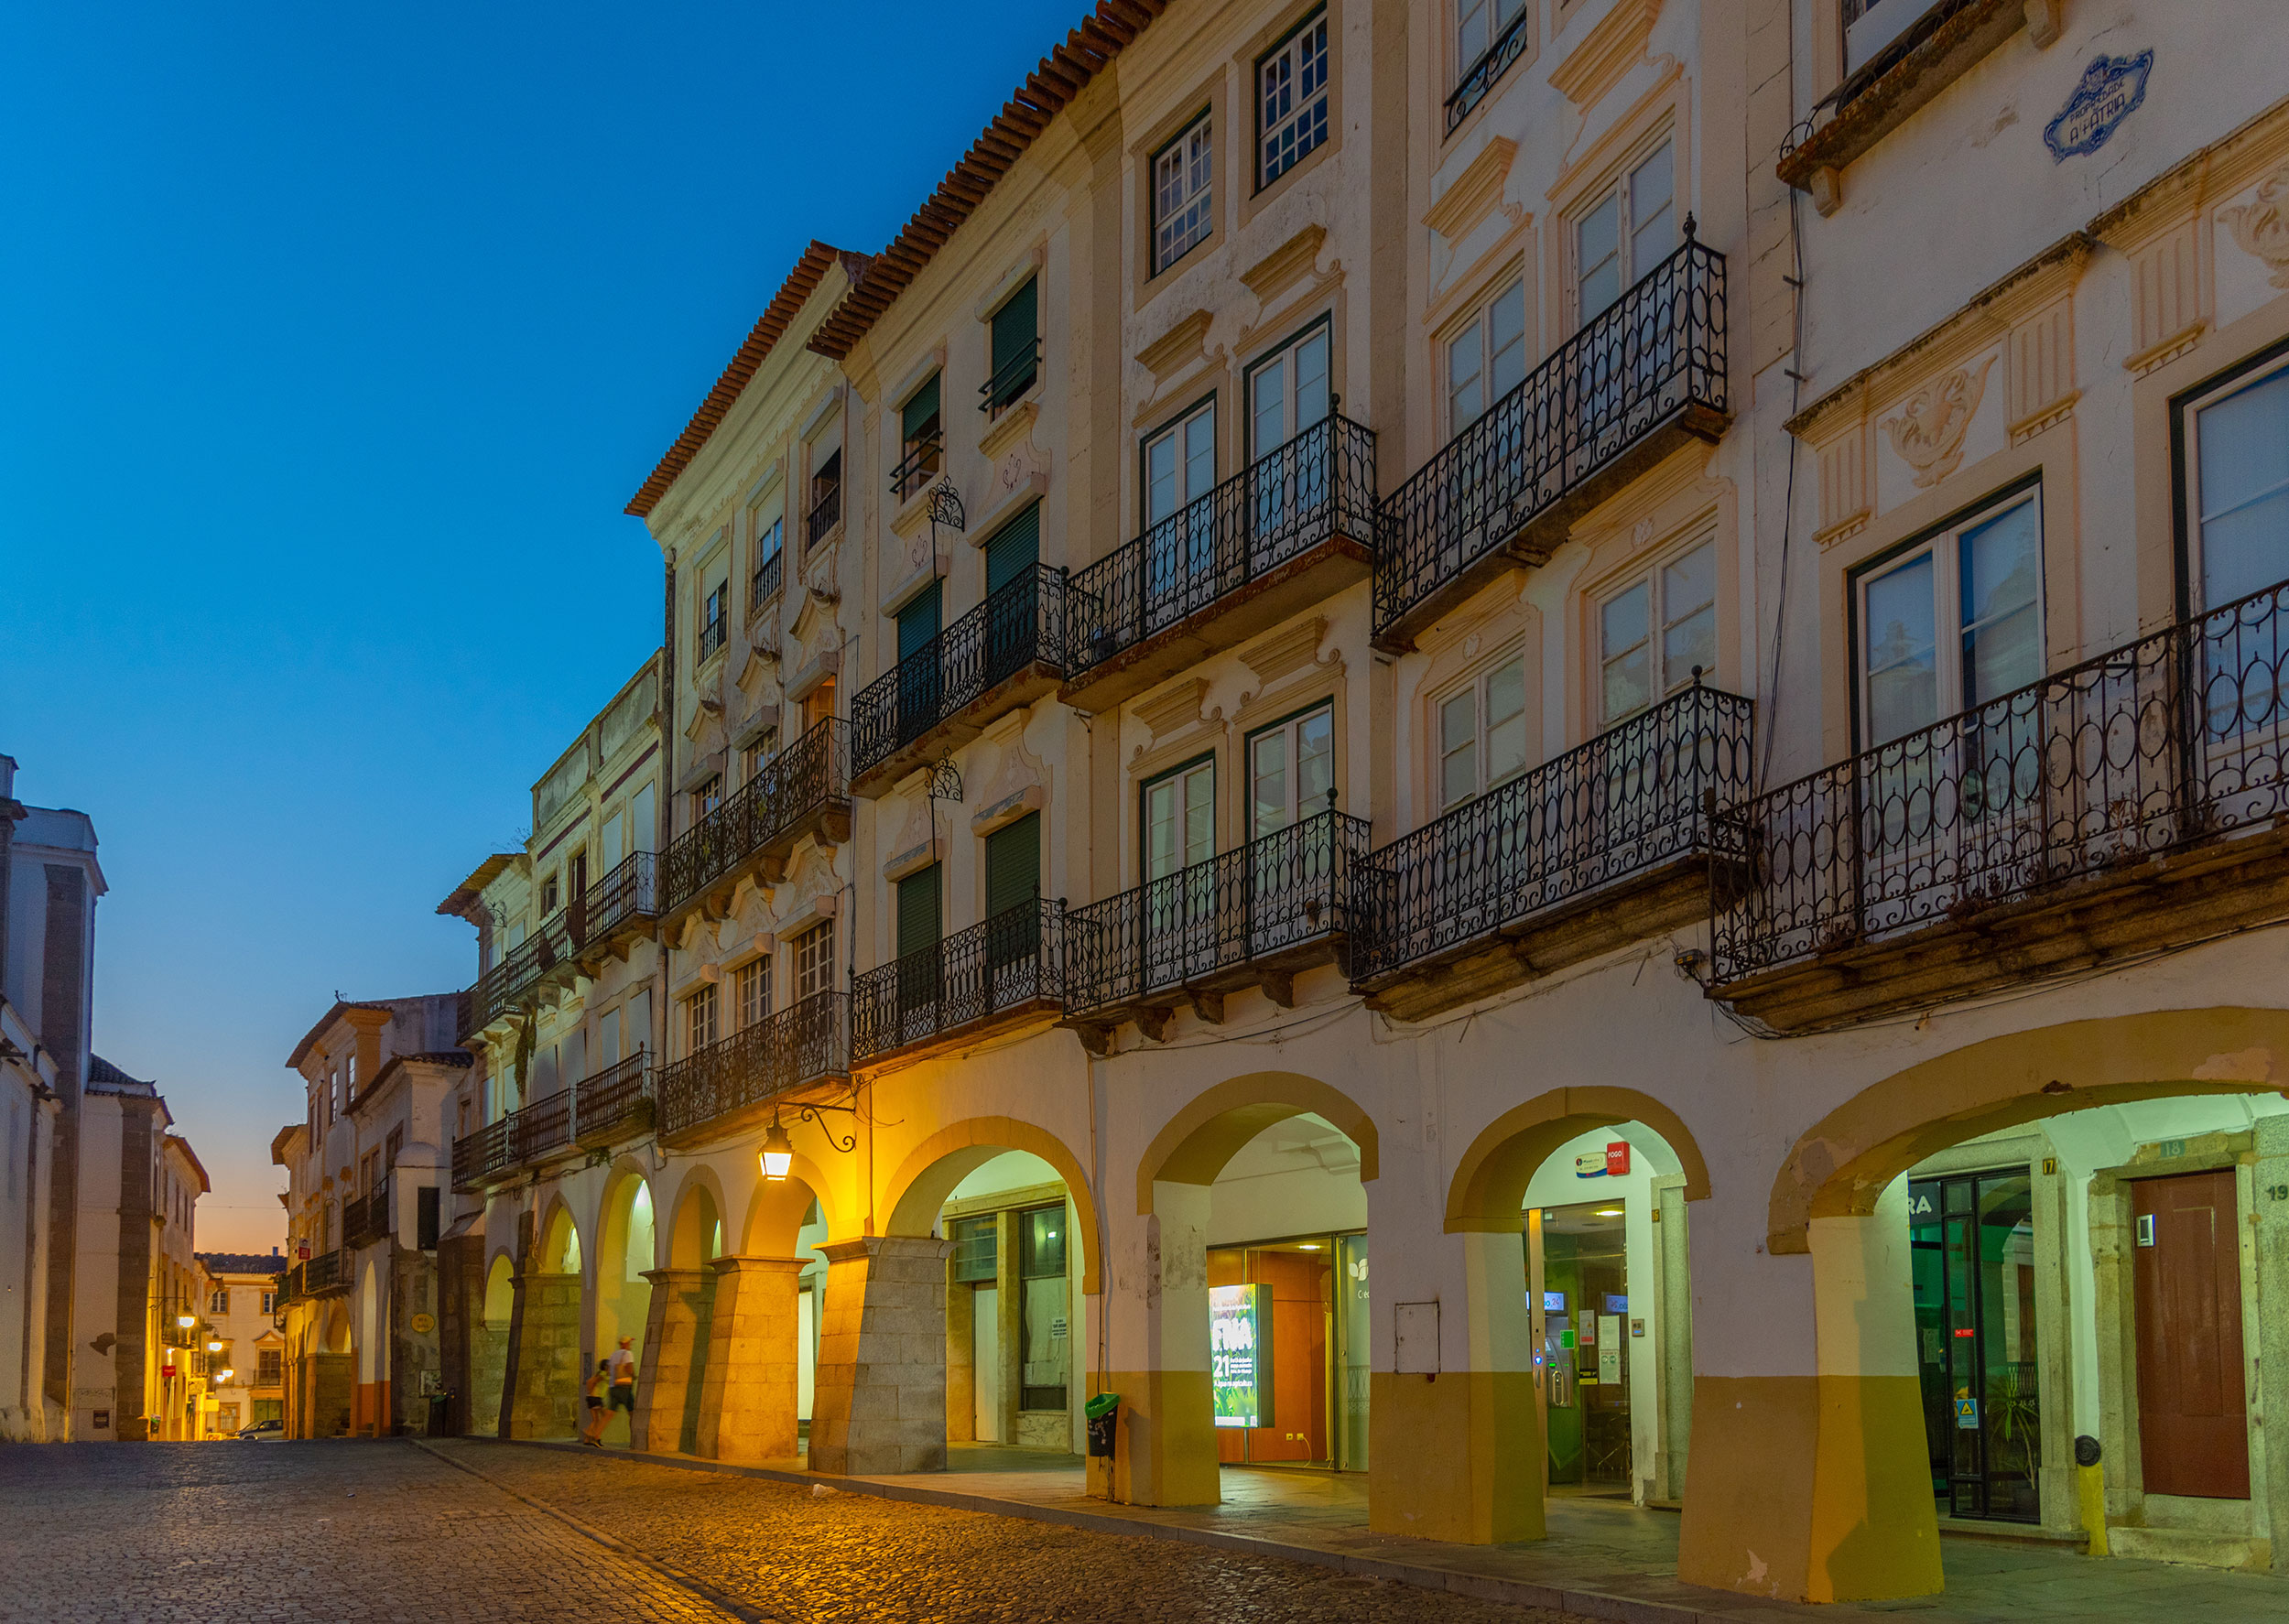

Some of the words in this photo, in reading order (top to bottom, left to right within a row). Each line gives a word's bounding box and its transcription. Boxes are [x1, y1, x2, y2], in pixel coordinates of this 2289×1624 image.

[2165, 1142, 2181, 1156] 18
[2043, 1158, 2055, 1175] 17
[2266, 1185, 2289, 1202] 19
[1213, 1354, 1230, 1378] 21
